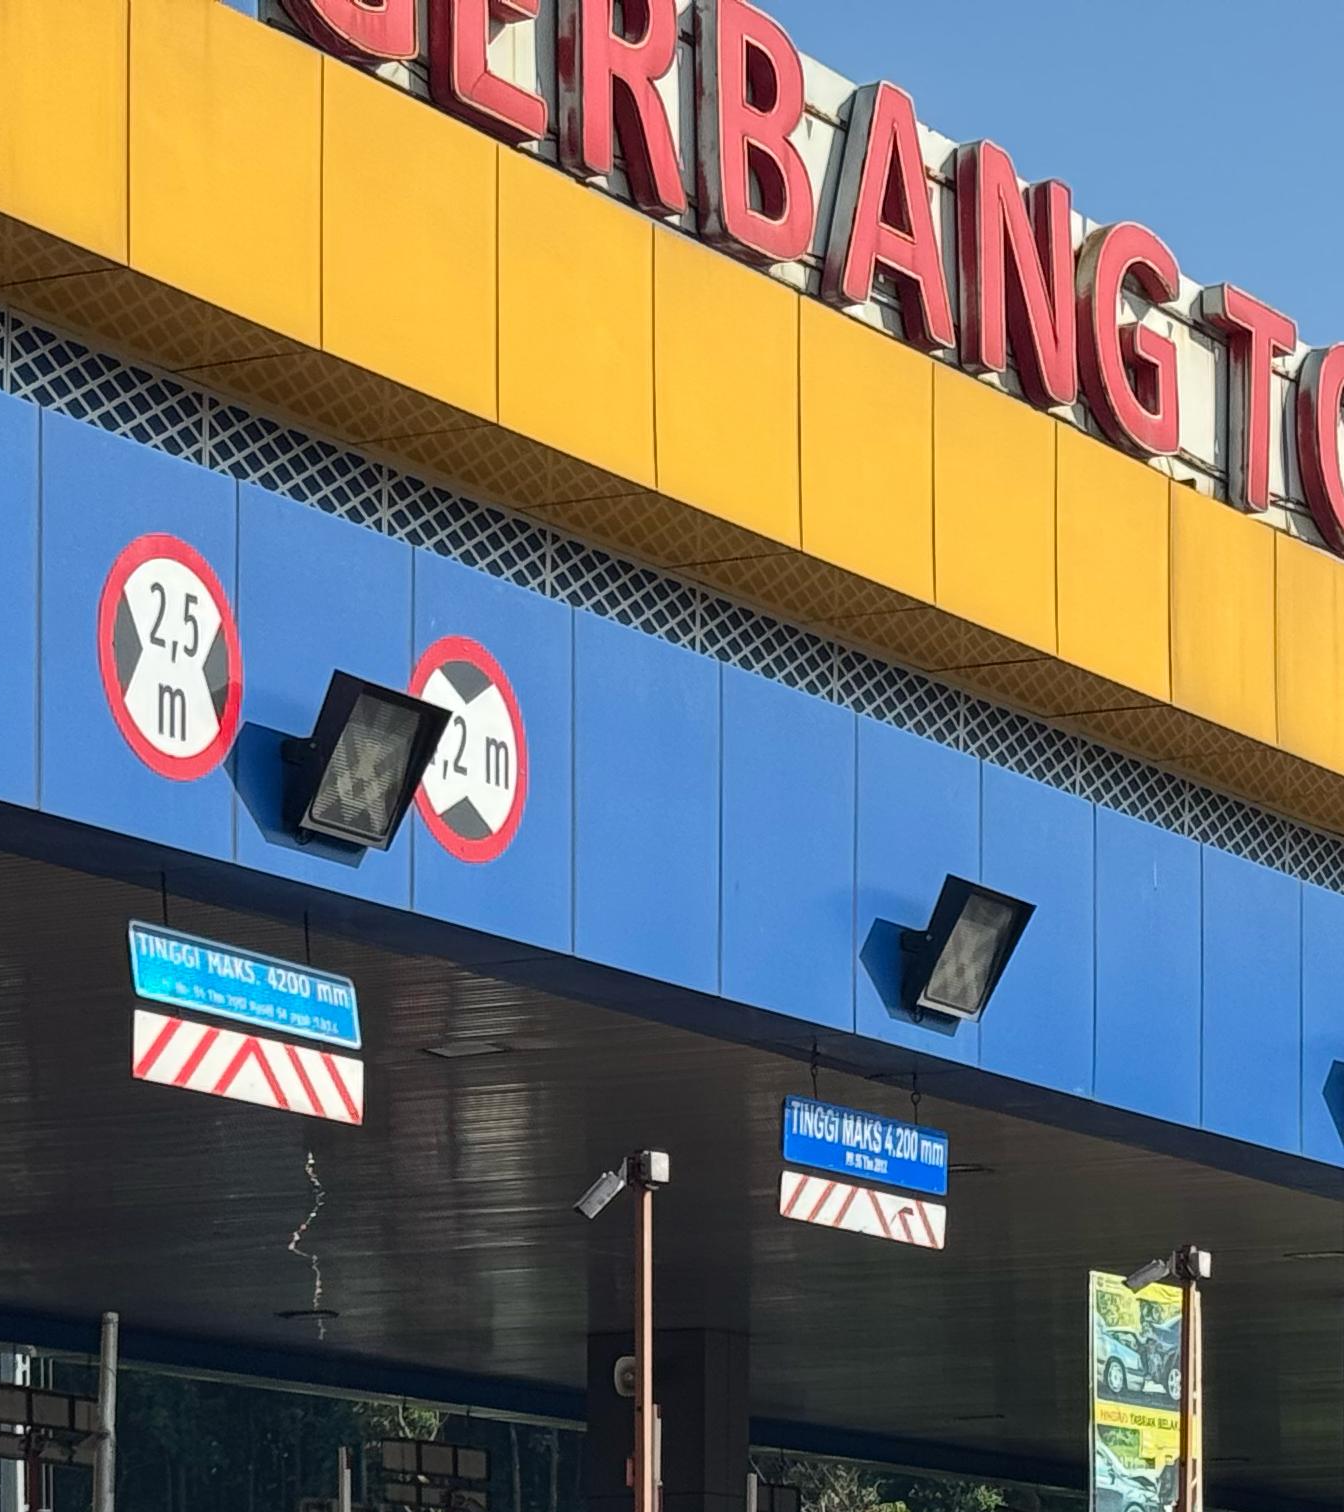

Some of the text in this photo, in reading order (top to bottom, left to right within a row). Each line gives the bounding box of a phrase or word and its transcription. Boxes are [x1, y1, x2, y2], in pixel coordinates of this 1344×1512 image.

[280, 0, 1182, 460] ERBANG
[149, 582, 200, 663] 2,5
[157, 683, 187, 742] m
[485, 736, 509, 790] m
[136, 932, 201, 969] TINGGI
[208, 952, 261, 985] MAKS.
[267, 965, 310, 999] 4200
[316, 981, 352, 1010] mm
[842, 1111, 882, 1154] MAKS
[884, 1124, 919, 1162] 4.200
[920, 1138, 944, 1168] mm
